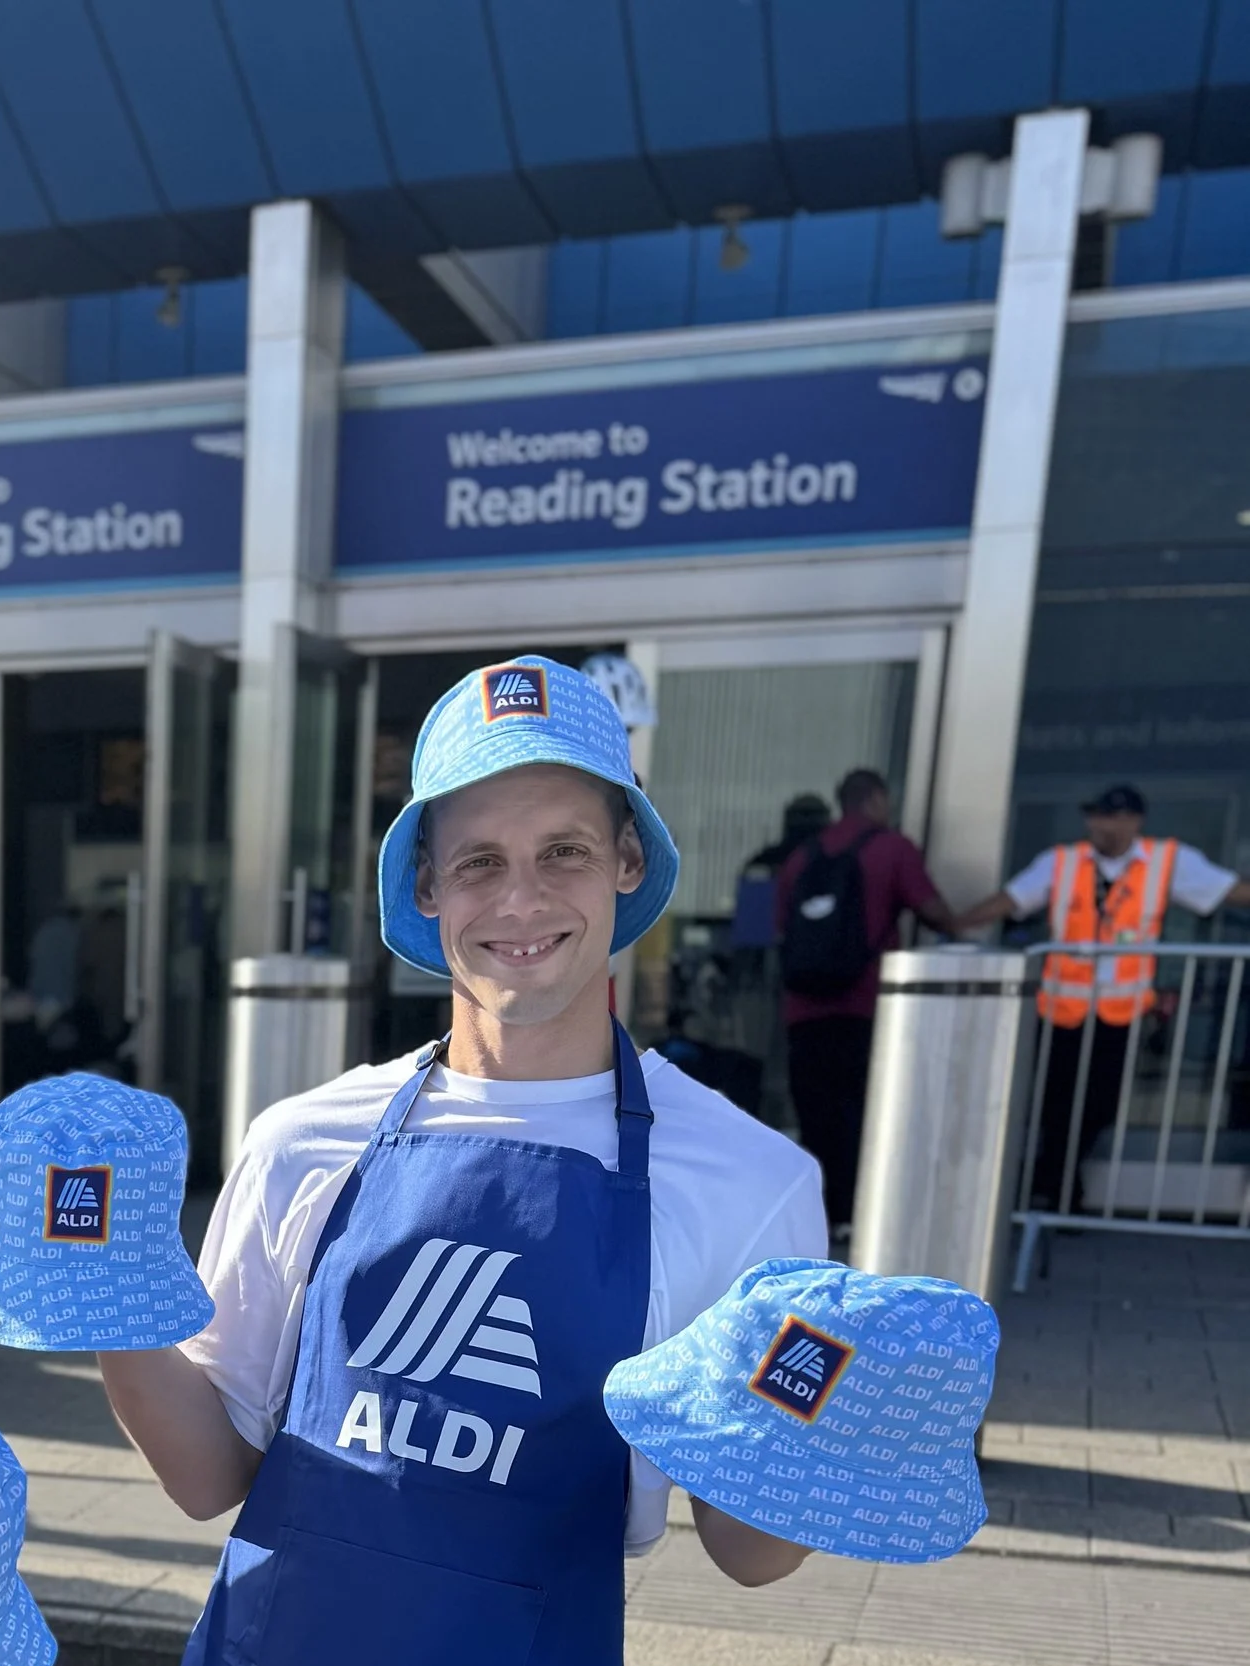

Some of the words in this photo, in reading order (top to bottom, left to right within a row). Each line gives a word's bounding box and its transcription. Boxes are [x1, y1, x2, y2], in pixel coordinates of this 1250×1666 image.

[446, 427, 603, 468] Welcome
[608, 422, 649, 456] to
[446, 469, 649, 529] Reading
[659, 452, 857, 514] Station
[21, 502, 183, 557] Station
[495, 696, 538, 709] ALDI
[57, 1117, 79, 1140] ALDI
[5, 1153, 32, 1165] ALDI
[115, 1148, 144, 1158] ALDI
[7, 1172, 31, 1186] ALDI
[117, 1168, 146, 1179] ALDI
[114, 1189, 145, 1200] ALDI
[149, 1181, 167, 1192] ALDI
[4, 1214, 26, 1227] ALDI
[57, 1214, 99, 1227] ALDI
[113, 1210, 143, 1221] ALDI
[112, 1231, 142, 1242] ALDI
[145, 1222, 166, 1234] ALDI
[30, 1248, 62, 1259] ALDI
[110, 1251, 141, 1262] ALDI
[36, 1269, 68, 1286] ALDI
[118, 1275, 145, 1286] ALDI
[41, 1287, 72, 1305] ALDI
[81, 1286, 114, 1301] ALDI
[122, 1292, 149, 1305] ALDI
[86, 1306, 118, 1321] ALDI
[154, 1300, 174, 1311] ALDI
[46, 1306, 78, 1325] ALDI
[127, 1313, 153, 1325] ALDI
[91, 1326, 123, 1342] ALDI
[158, 1320, 178, 1331] ALDI
[50, 1326, 82, 1345] ALDI
[132, 1334, 157, 1345] ALDI
[866, 1336, 906, 1357] ALDI
[916, 1341, 952, 1359] ALDI
[855, 1356, 895, 1379] ALDI
[904, 1363, 943, 1379] ALDI
[767, 1368, 817, 1401] ALDI
[842, 1376, 884, 1399] ALDI
[892, 1384, 933, 1401] ALDI
[831, 1396, 871, 1418] ALDI
[881, 1405, 919, 1421] ALDI
[930, 1401, 965, 1415] ALDI
[818, 1416, 858, 1437] ALDI
[335, 1391, 525, 1485] ALDI
[807, 1435, 848, 1457] ALDI
[670, 1448, 710, 1463] ALDI
[719, 1445, 759, 1462] ALDI
[857, 1443, 898, 1462] ALDI
[667, 1467, 703, 1483] ALDI
[713, 1467, 754, 1483] ALDI
[764, 1462, 806, 1481] ALDI
[815, 1464, 854, 1483] ALDI
[708, 1489, 748, 1506] ALDI
[758, 1485, 799, 1504] ALDI
[808, 1487, 850, 1505] ALDI
[859, 1484, 896, 1504] ALDI
[905, 1489, 938, 1507] ALDI
[751, 1508, 791, 1526] ALDI
[801, 1510, 842, 1528] ALDI
[852, 1508, 889, 1526] ALDI
[897, 1511, 931, 1530] ALDI
[794, 1531, 835, 1549] ALDI
[845, 1530, 881, 1547] ALDI
[887, 1533, 924, 1552] ALDI
[3, 1614, 16, 1652] ALDI
